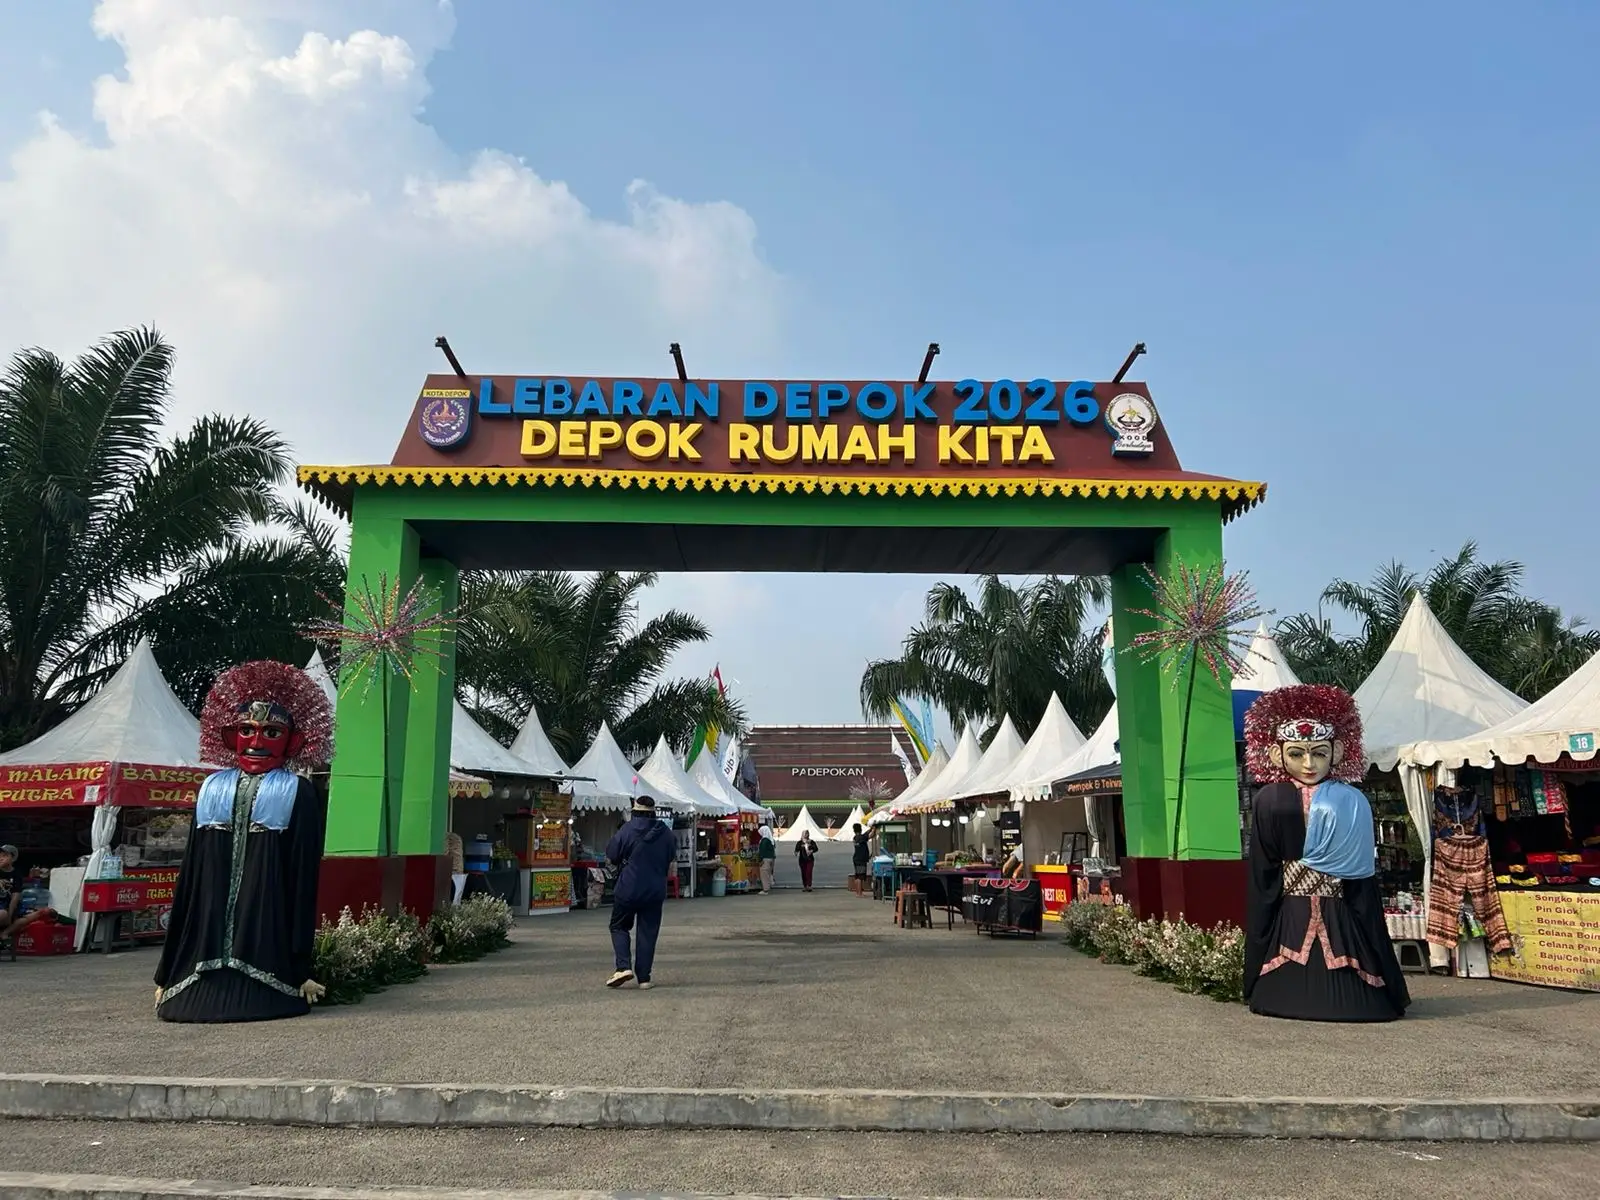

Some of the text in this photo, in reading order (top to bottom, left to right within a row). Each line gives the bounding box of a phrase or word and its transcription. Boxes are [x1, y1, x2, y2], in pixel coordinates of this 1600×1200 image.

[478, 378, 719, 419] LEBARAN
[743, 381, 938, 422] DEPOK
[953, 379, 1100, 424] 2026
[520, 419, 1055, 466] DEPOK RUMAH KITA
[8, 766, 207, 784] MALANG BAKSO
[791, 767, 864, 777] PADEPOKAN
[0, 786, 197, 802] PUTRA DUA
[1534, 894, 1573, 904] Songko
[1535, 905, 1552, 913] Pin
[1537, 917, 1576, 926] Boneka
[1537, 928, 1573, 938] Celana
[1539, 940, 1575, 950] Celana
[1535, 963, 1595, 977] ondel-ondel
